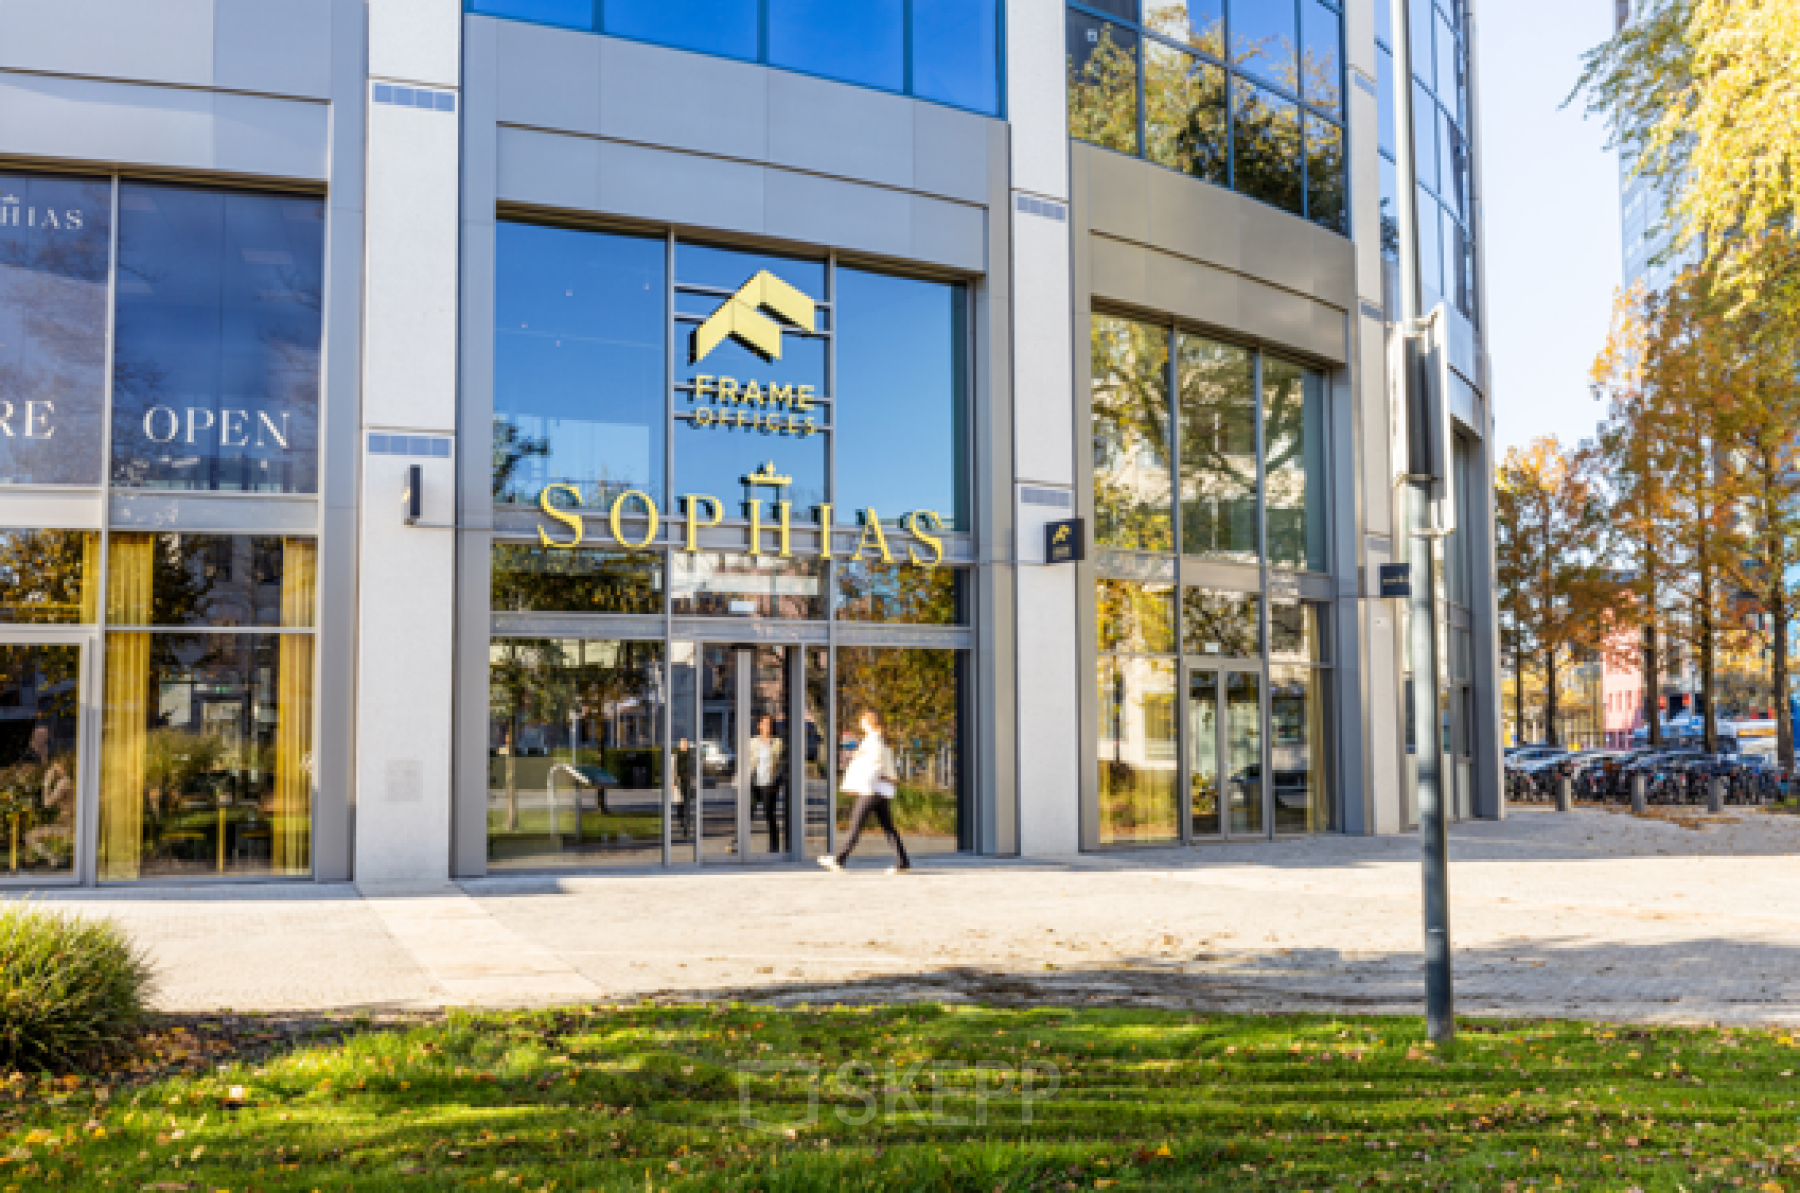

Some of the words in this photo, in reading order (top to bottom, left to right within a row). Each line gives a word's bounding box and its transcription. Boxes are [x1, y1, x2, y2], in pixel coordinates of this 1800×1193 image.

[696, 373, 816, 411] FRAME
[142, 405, 290, 449] OPEN
[696, 406, 816, 436] OFFICES
[537, 483, 945, 567] SOPHIAS
